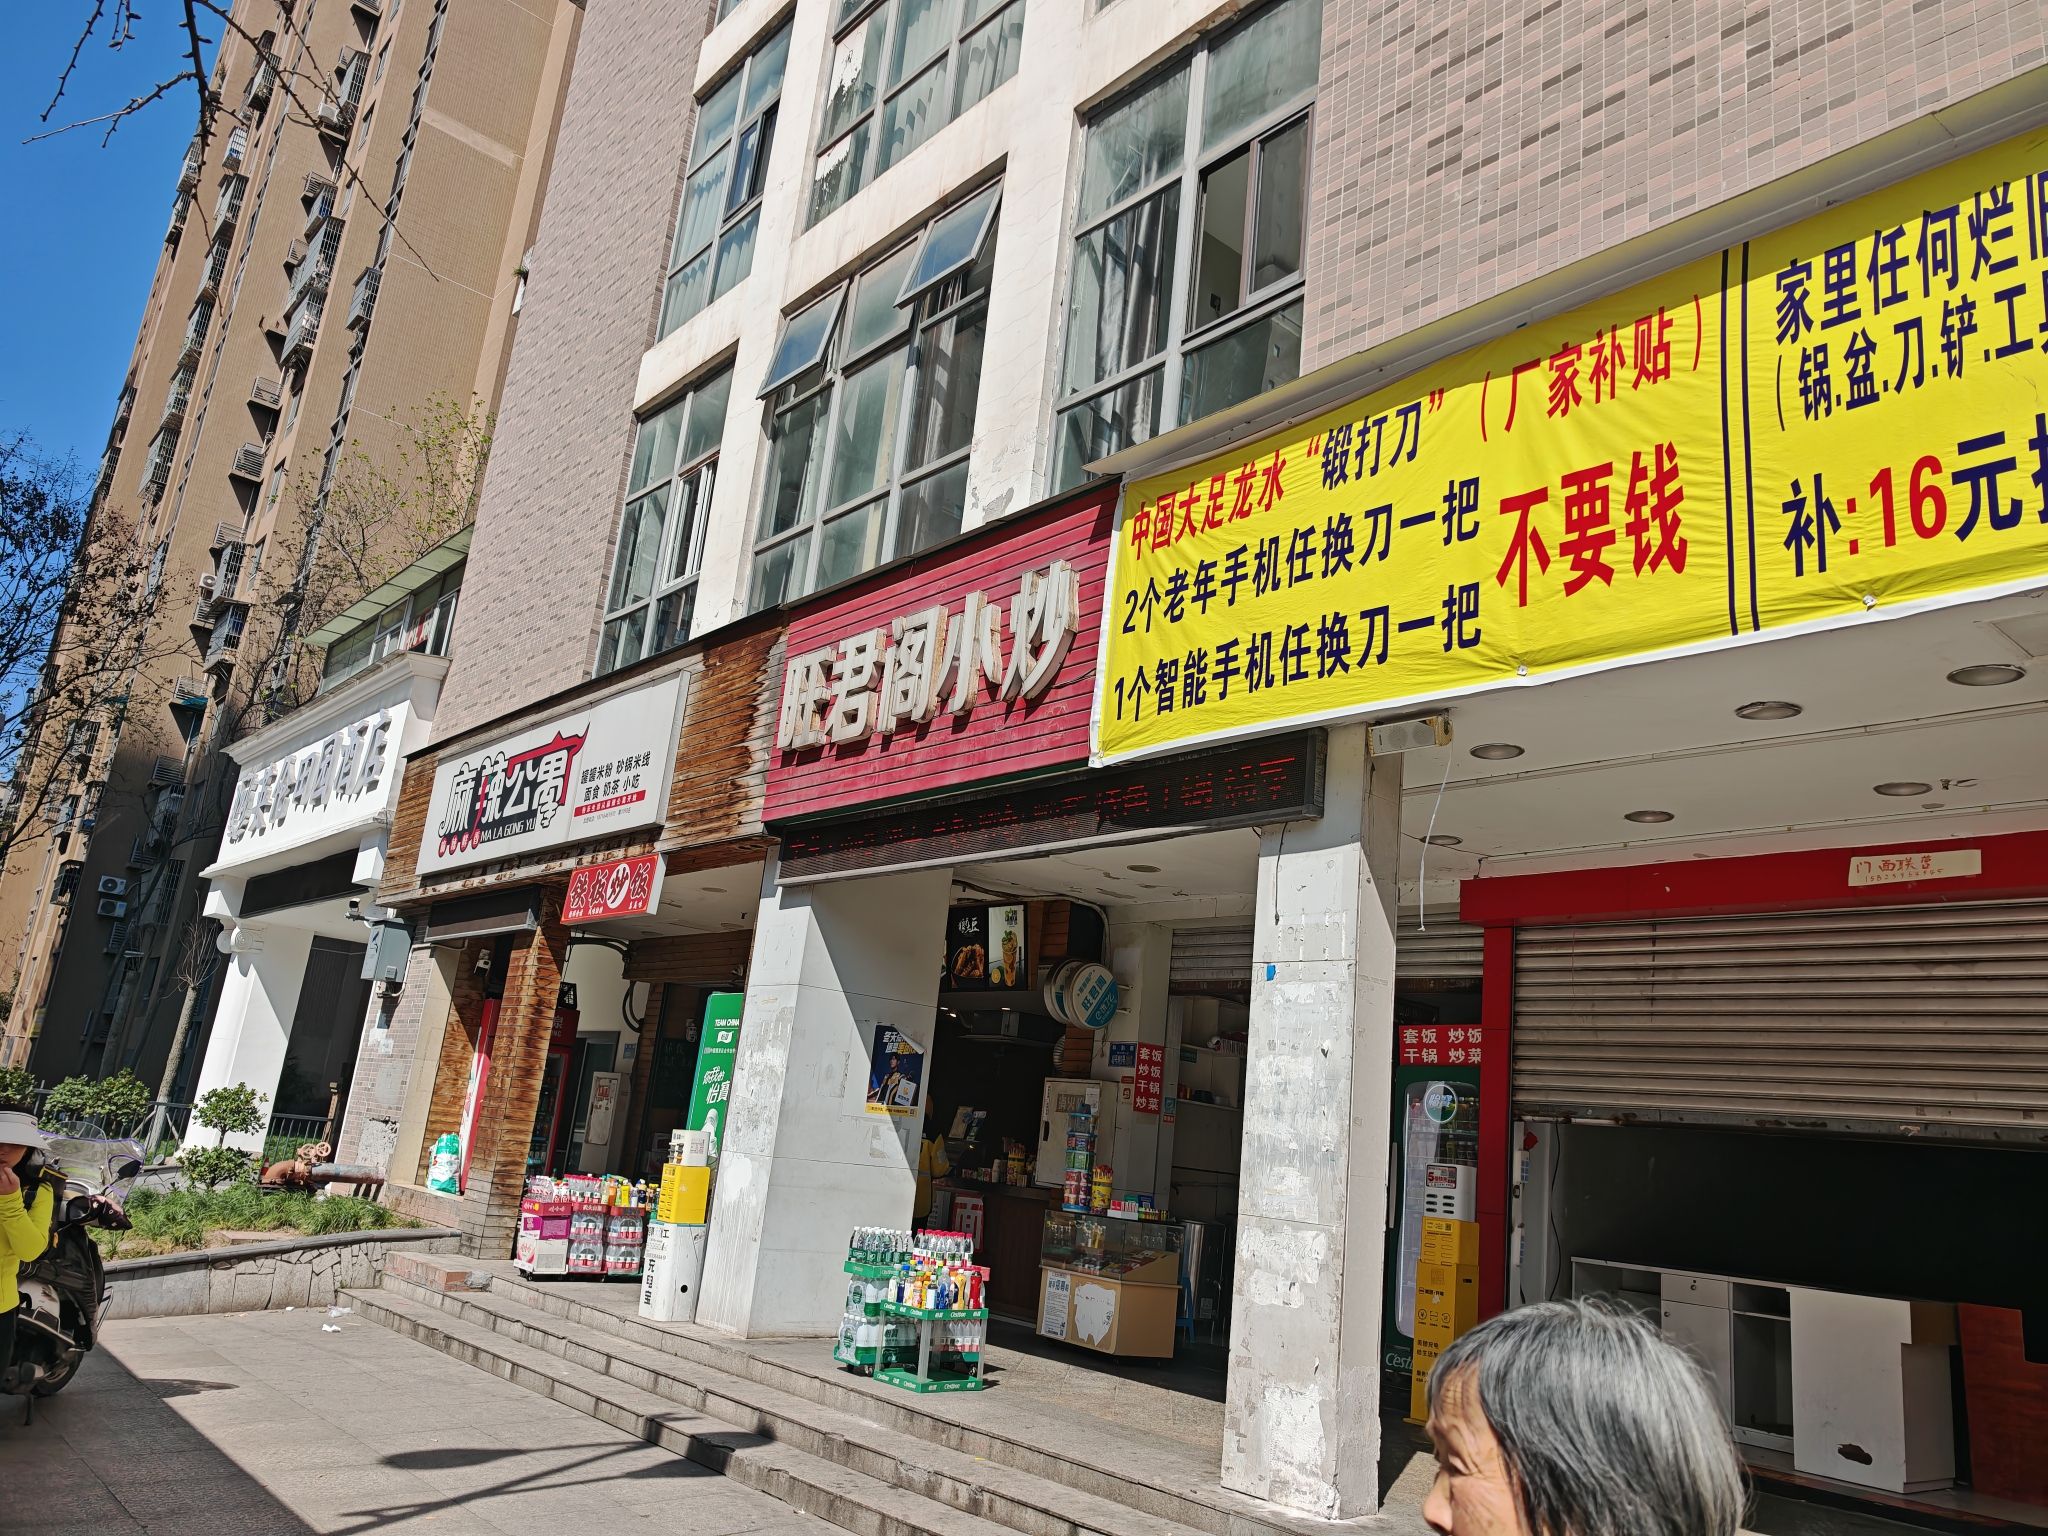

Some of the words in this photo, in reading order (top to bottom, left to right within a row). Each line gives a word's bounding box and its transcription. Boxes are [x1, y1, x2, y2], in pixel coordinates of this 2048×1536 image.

[1131, 449, 1286, 563] 中国大足龙水
[1496, 440, 1689, 608] 不要钱
[1122, 476, 1481, 635] 2个老年手机任换刀一把
[777, 559, 1080, 751] 旺君阁小炒
[1113, 581, 1482, 722] 1个智能手机任换刀一把
[616, 750, 651, 775] 砂锅米线
[438, 738, 577, 837] 麻辣公寓
[584, 784, 600, 803] 面食
[603, 778, 620, 797] 奶茶
[623, 773, 641, 792] 小吃
[481, 829, 493, 841] MA
[493, 827, 504, 839] LA
[504, 821, 525, 836] GONG
[525, 816, 537, 832] YU
[569, 862, 651, 909] 铁板炒饭
[714, 1019, 727, 1027] TEAM
[727, 1018, 740, 1026] CHINA
[1403, 1028, 1437, 1044] 套饭
[1448, 1028, 1482, 1043] 炒饭
[1139, 1047, 1162, 1062] 套饭
[1403, 1048, 1438, 1063] 干锅
[1448, 1048, 1482, 1064] 炒菜
[1138, 1063, 1161, 1078] 炒饭
[1137, 1079, 1160, 1095] 干锅
[1135, 1095, 1159, 1111] 炒菜
